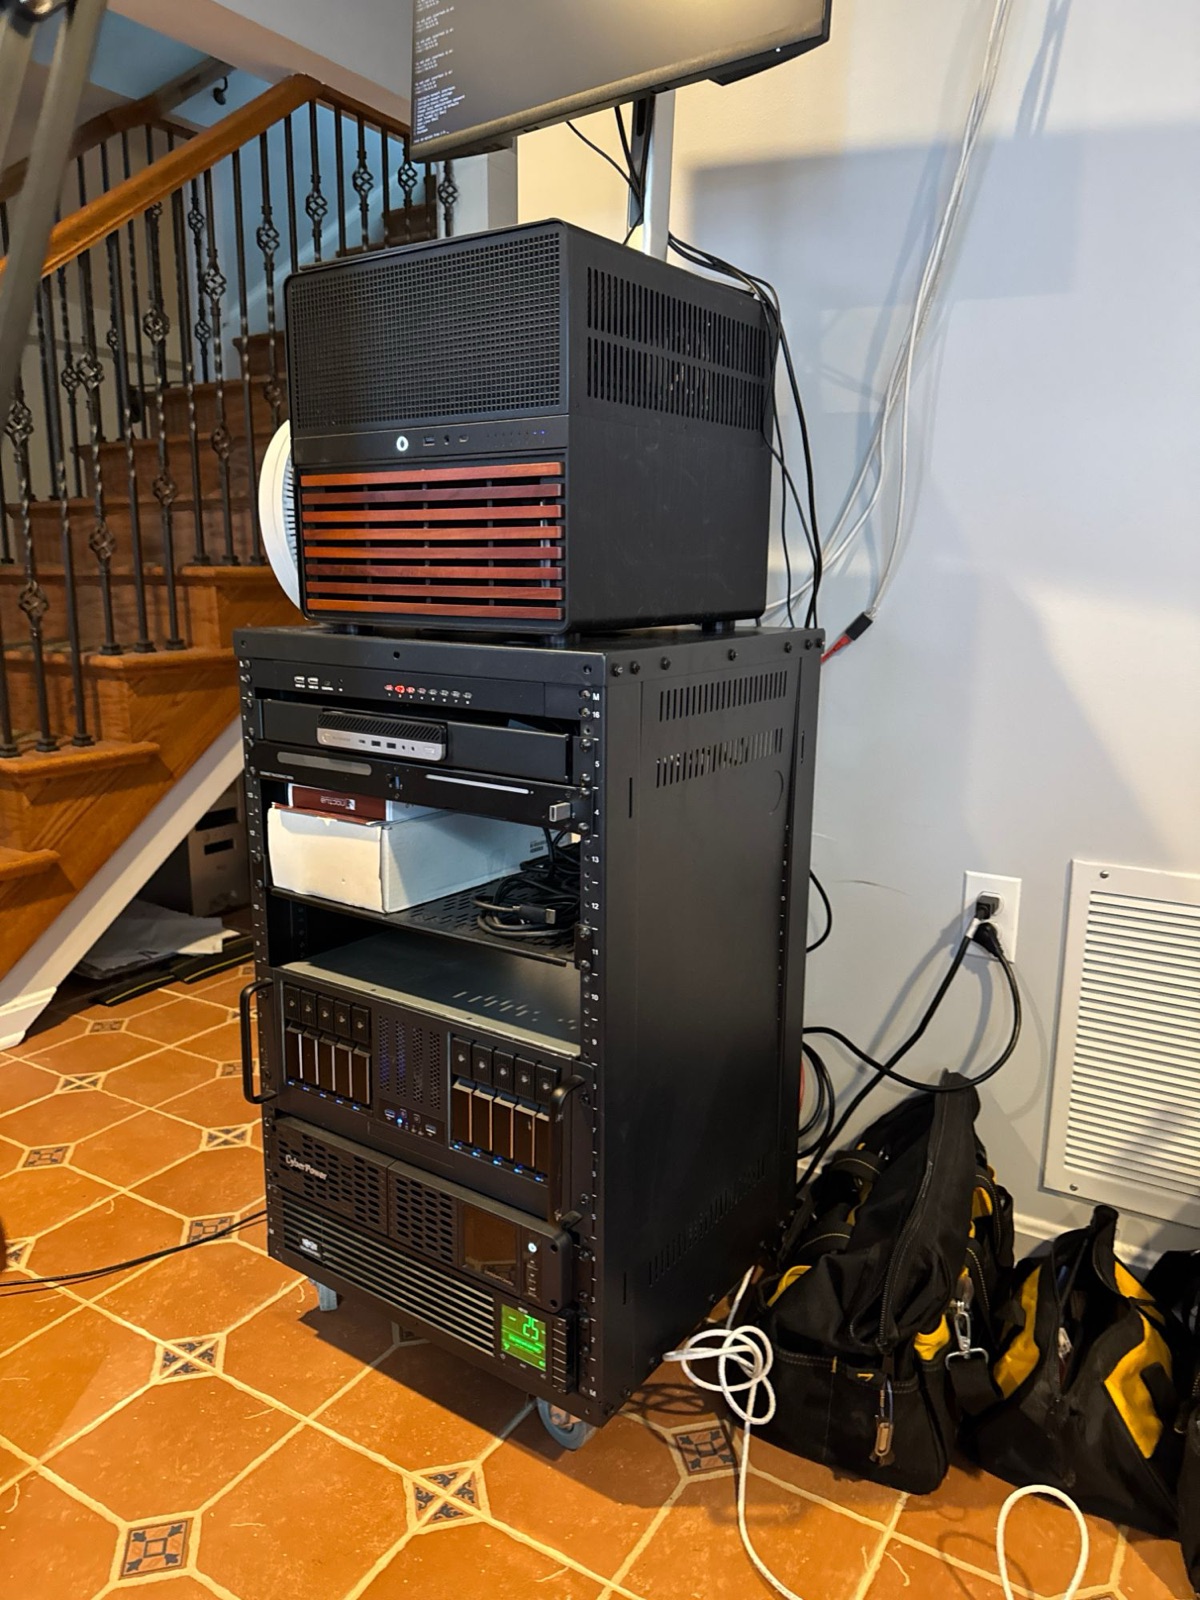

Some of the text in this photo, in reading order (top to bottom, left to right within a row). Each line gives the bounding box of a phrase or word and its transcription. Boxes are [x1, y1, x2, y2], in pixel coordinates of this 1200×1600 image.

[592, 711, 601, 719] 16
[591, 855, 600, 864] 13
[591, 902, 600, 910] 12
